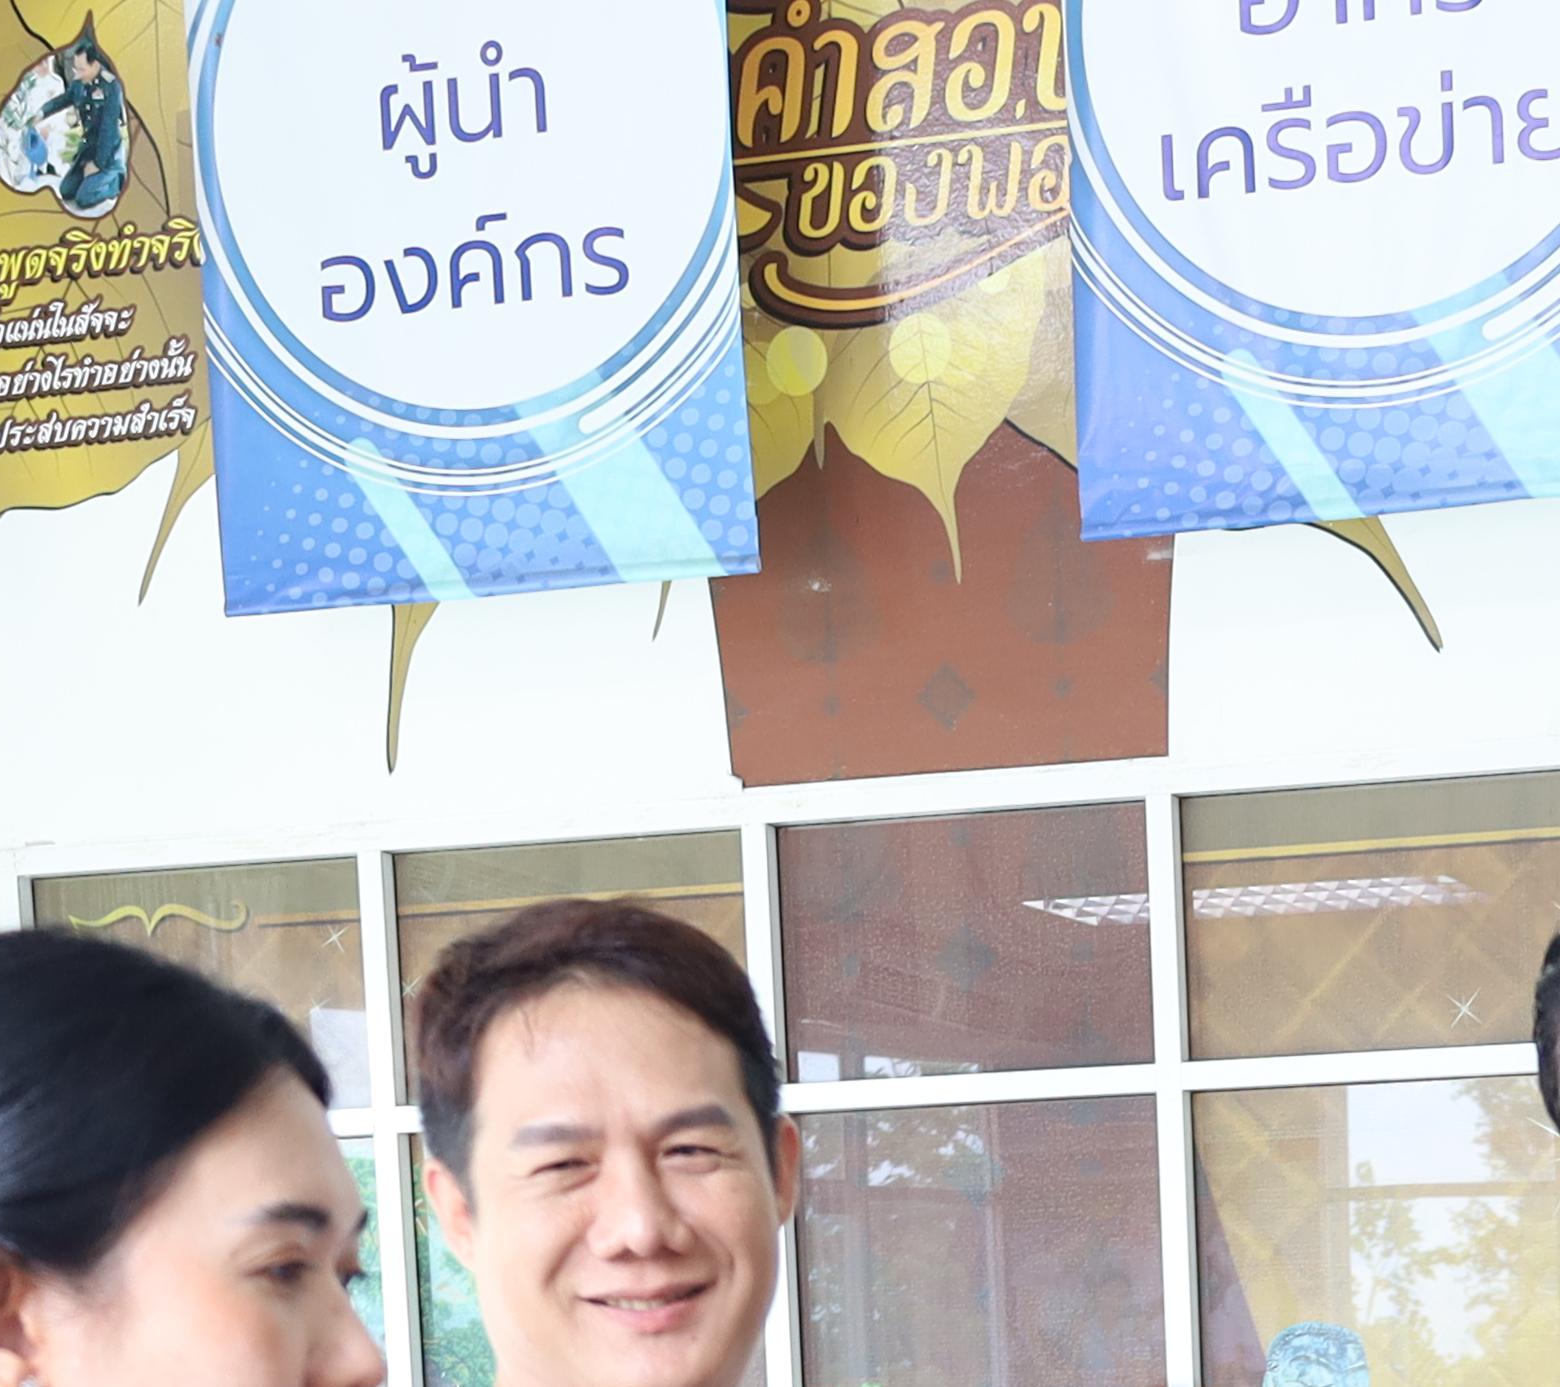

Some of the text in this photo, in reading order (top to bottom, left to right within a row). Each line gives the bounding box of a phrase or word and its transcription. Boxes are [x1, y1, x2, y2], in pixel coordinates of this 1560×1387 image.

[380, 40, 547, 179] ผู้นำ
[320, 213, 630, 322] องค์กร
